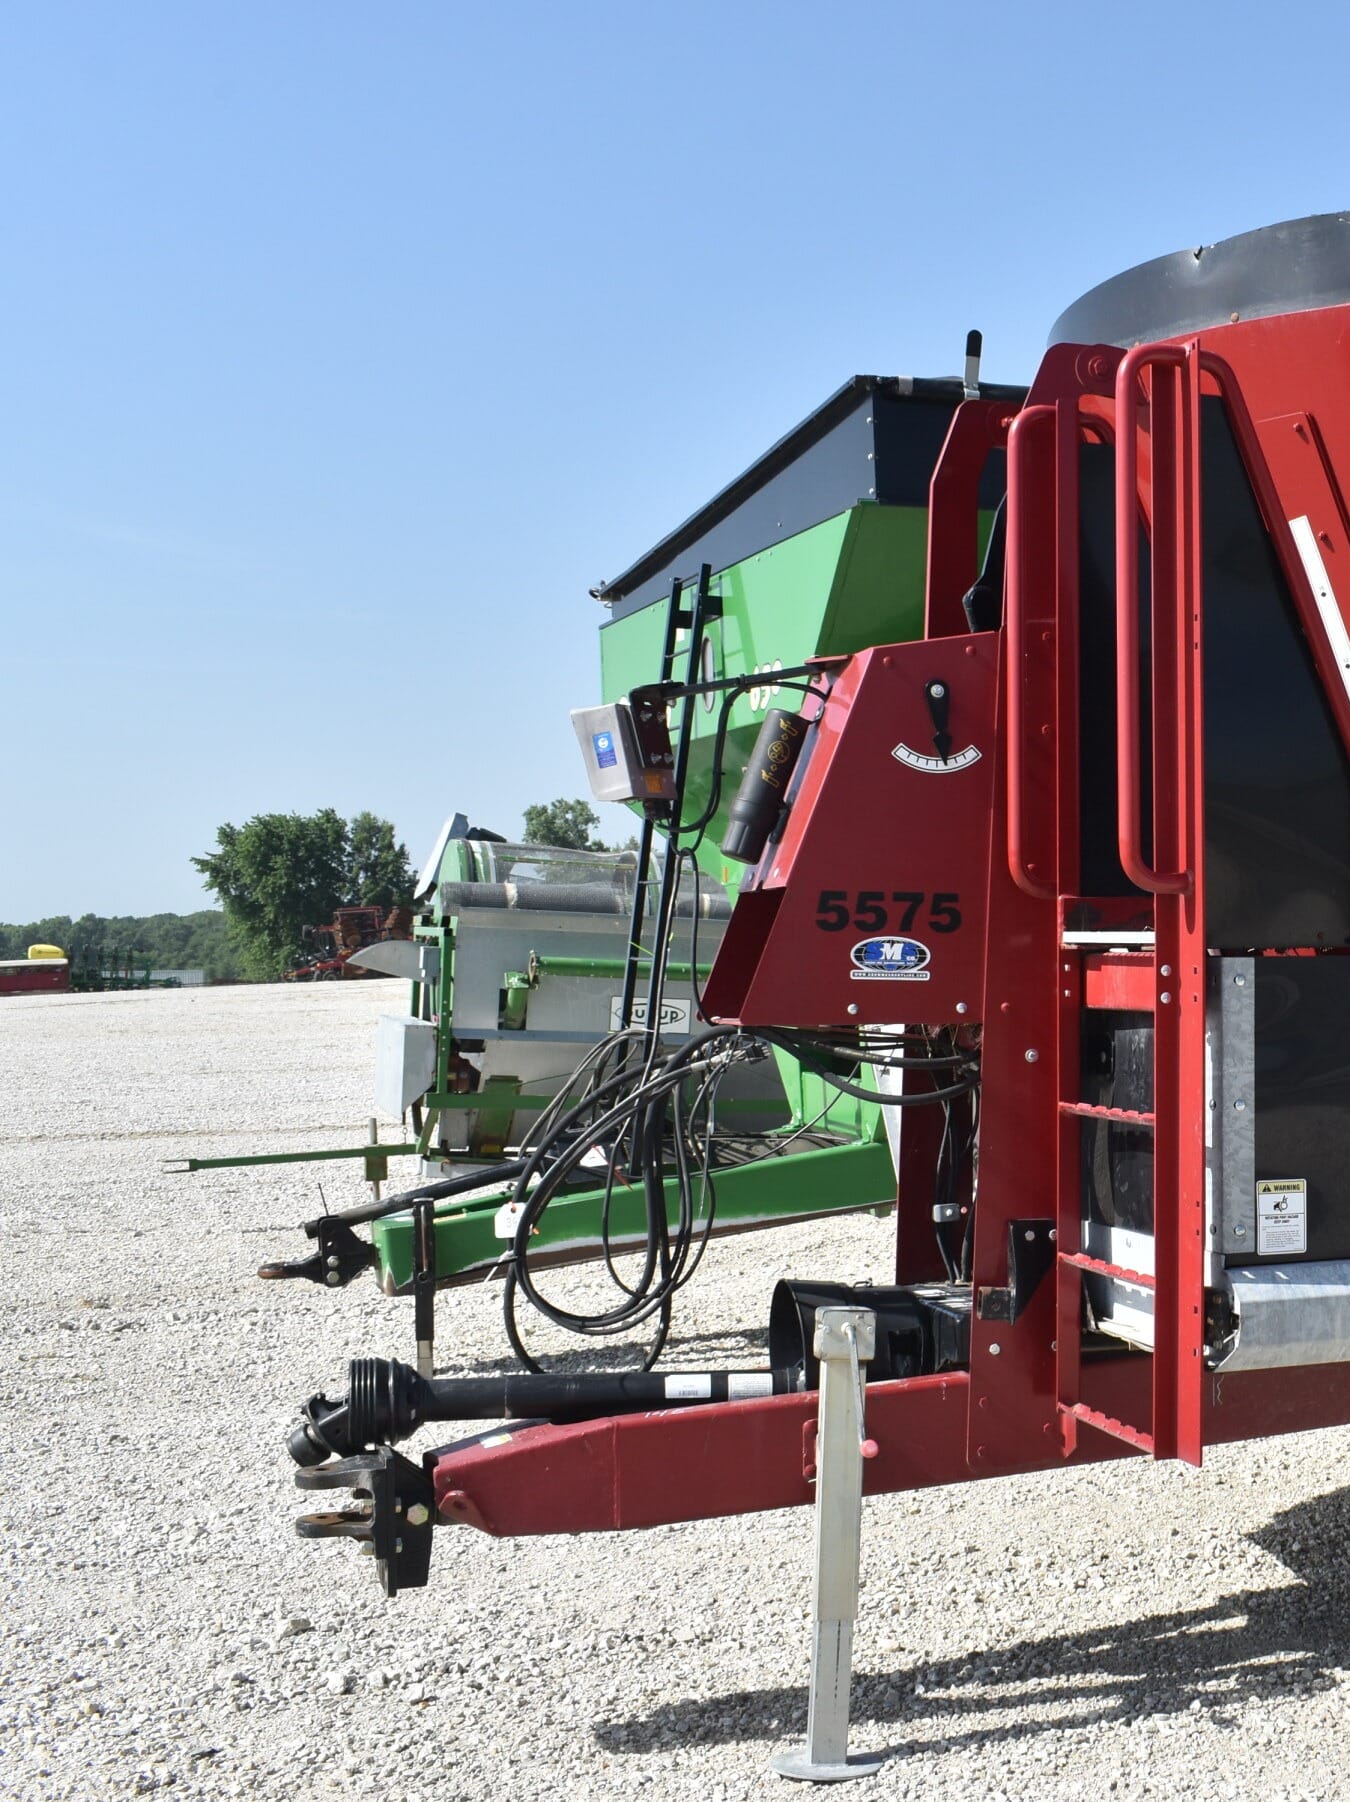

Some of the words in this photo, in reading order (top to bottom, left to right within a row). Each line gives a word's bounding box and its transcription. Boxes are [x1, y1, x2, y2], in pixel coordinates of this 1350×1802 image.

[815, 891, 962, 934] 5575
[865, 942, 917, 961] SMS
[1273, 1184, 1301, 1192] WARNING
